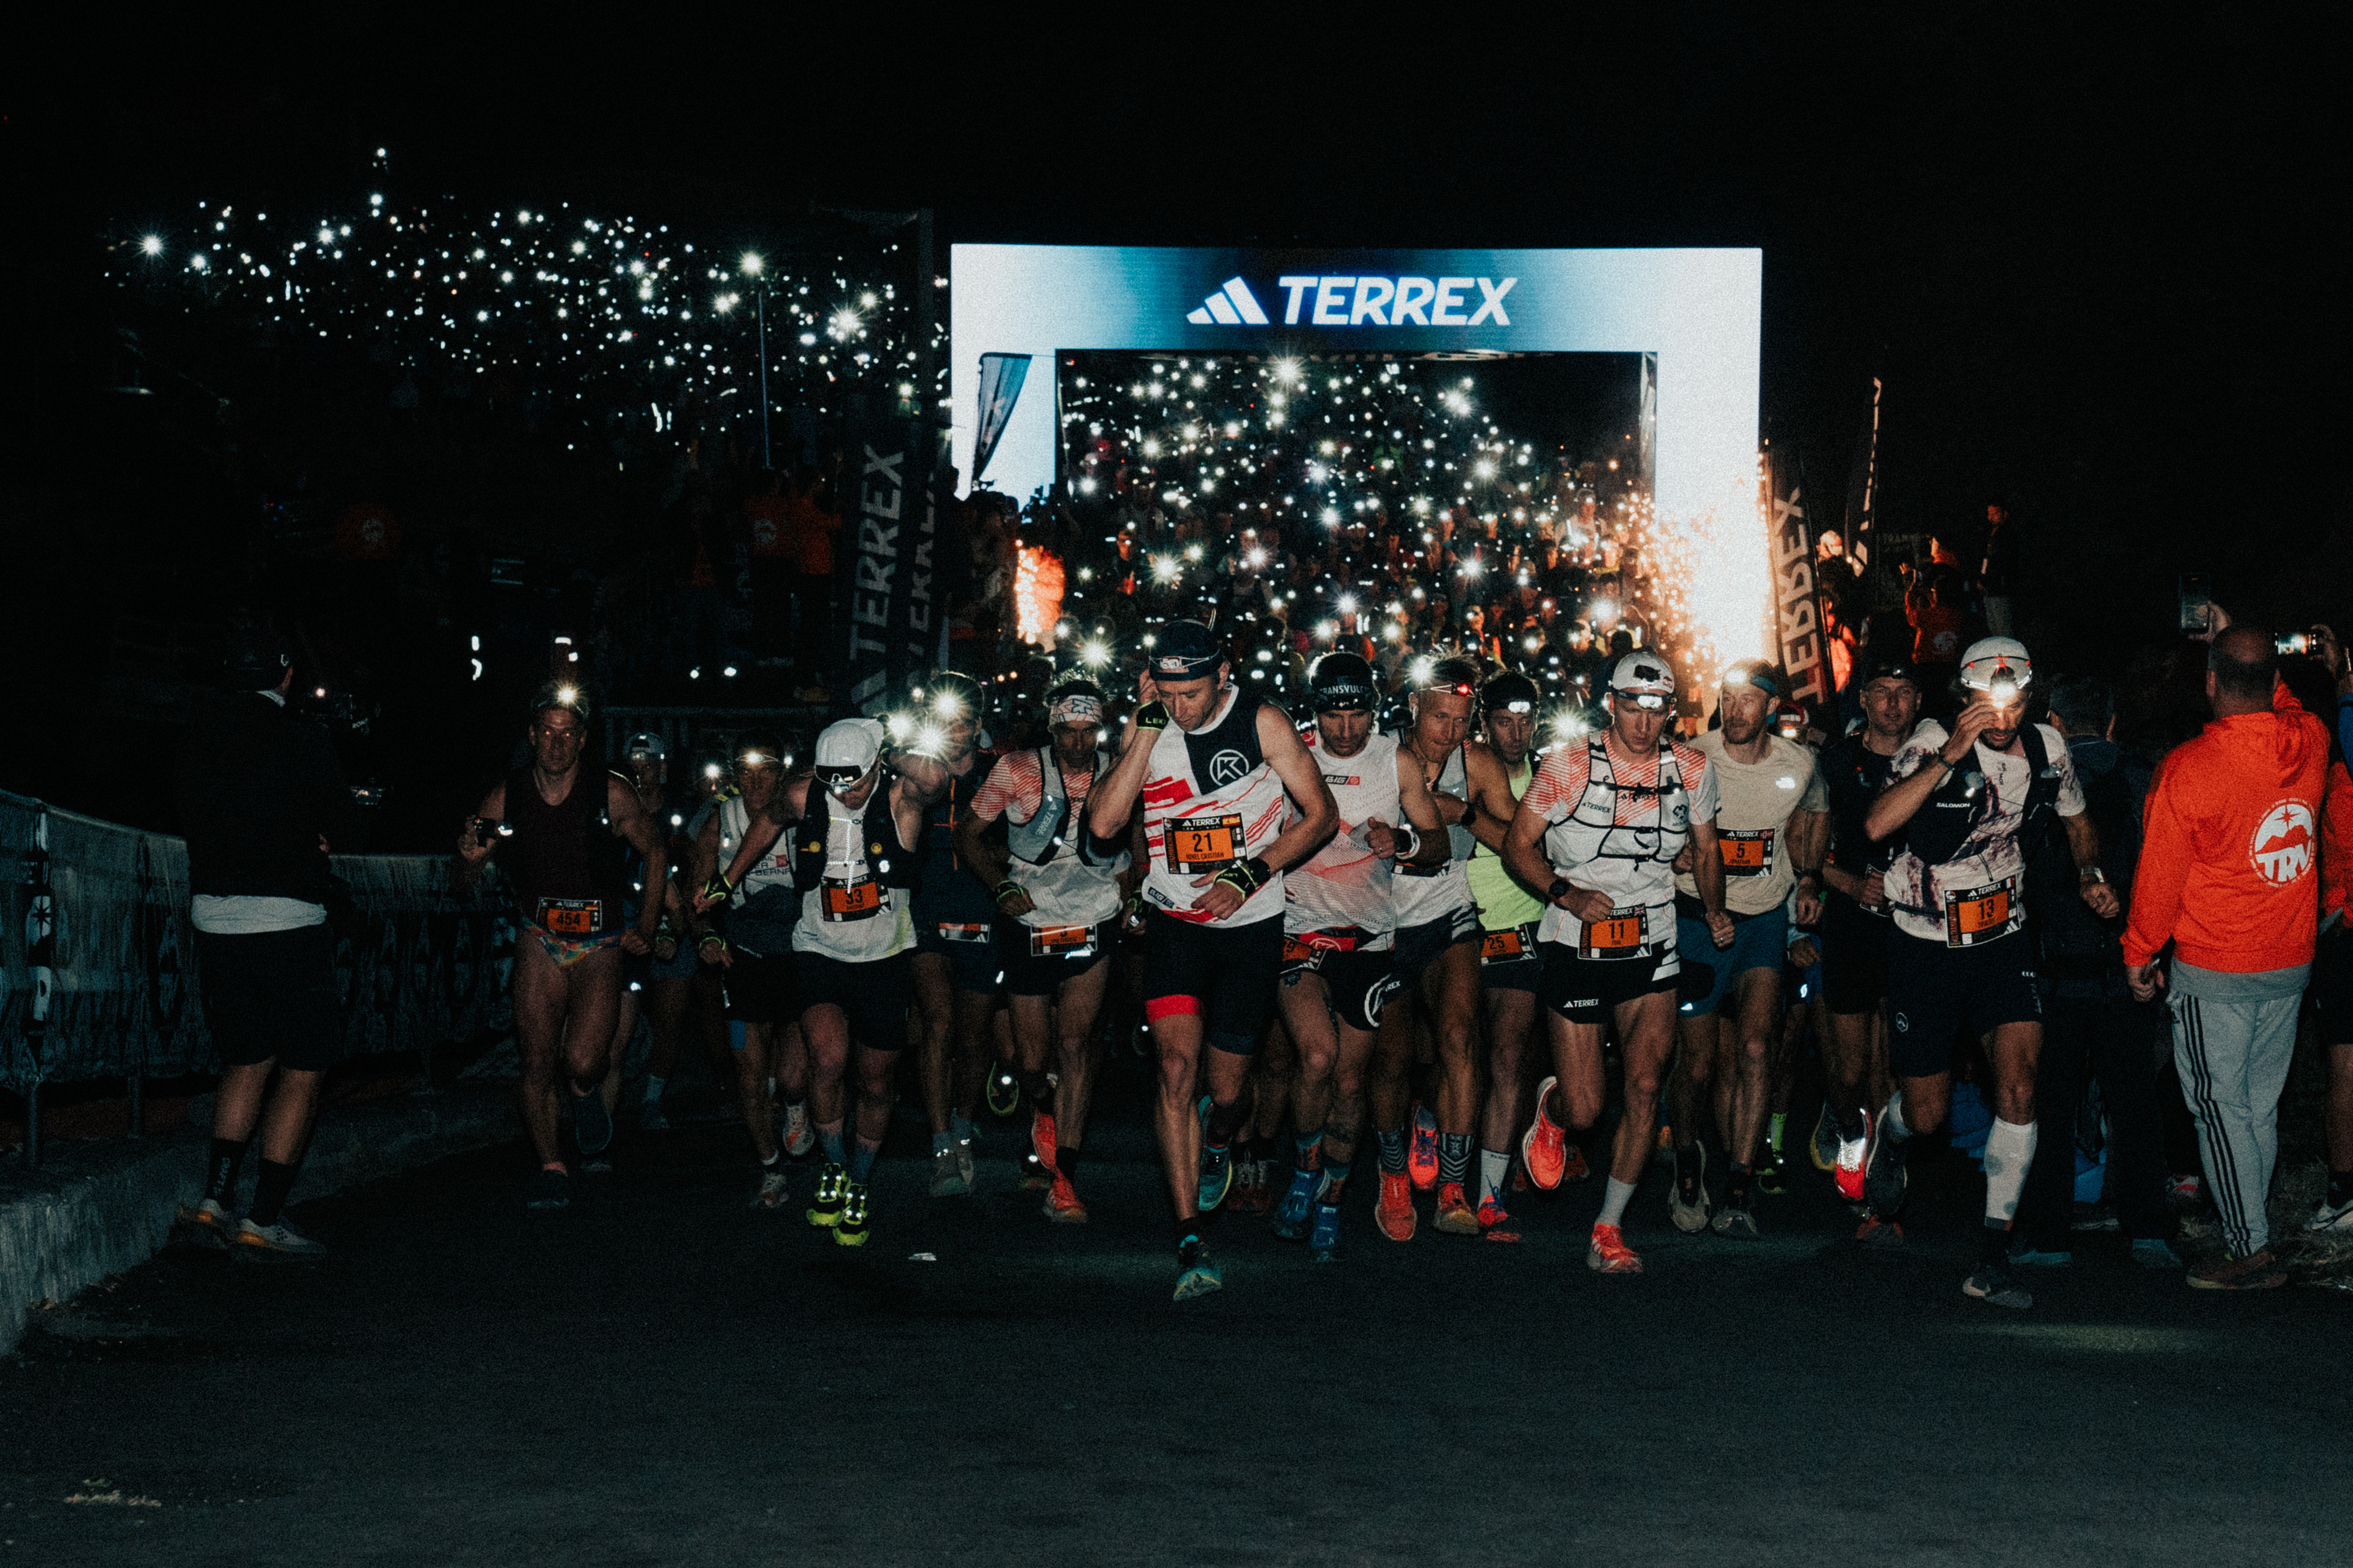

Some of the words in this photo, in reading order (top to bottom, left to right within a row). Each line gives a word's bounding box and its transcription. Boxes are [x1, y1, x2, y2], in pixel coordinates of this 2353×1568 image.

[1279, 276, 1517, 325] TERREX
[849, 444, 904, 660] TERREX
[1587, 802, 1611, 813] TERREX
[1192, 817, 1220, 826] TERREX
[1192, 833, 1212, 852] 21
[1201, 852, 1224, 860] CRISTIAN
[1737, 843, 1745, 858] 5
[844, 875, 867, 884] TRREX
[1978, 882, 2002, 895] TERREX
[845, 889, 863, 904] 33
[1978, 899, 1994, 919] 13
[557, 912, 580, 926] 454
[1609, 922, 1624, 938] 11
[1487, 936, 1505, 949] 25
[1573, 998, 1599, 1008] TERREX
